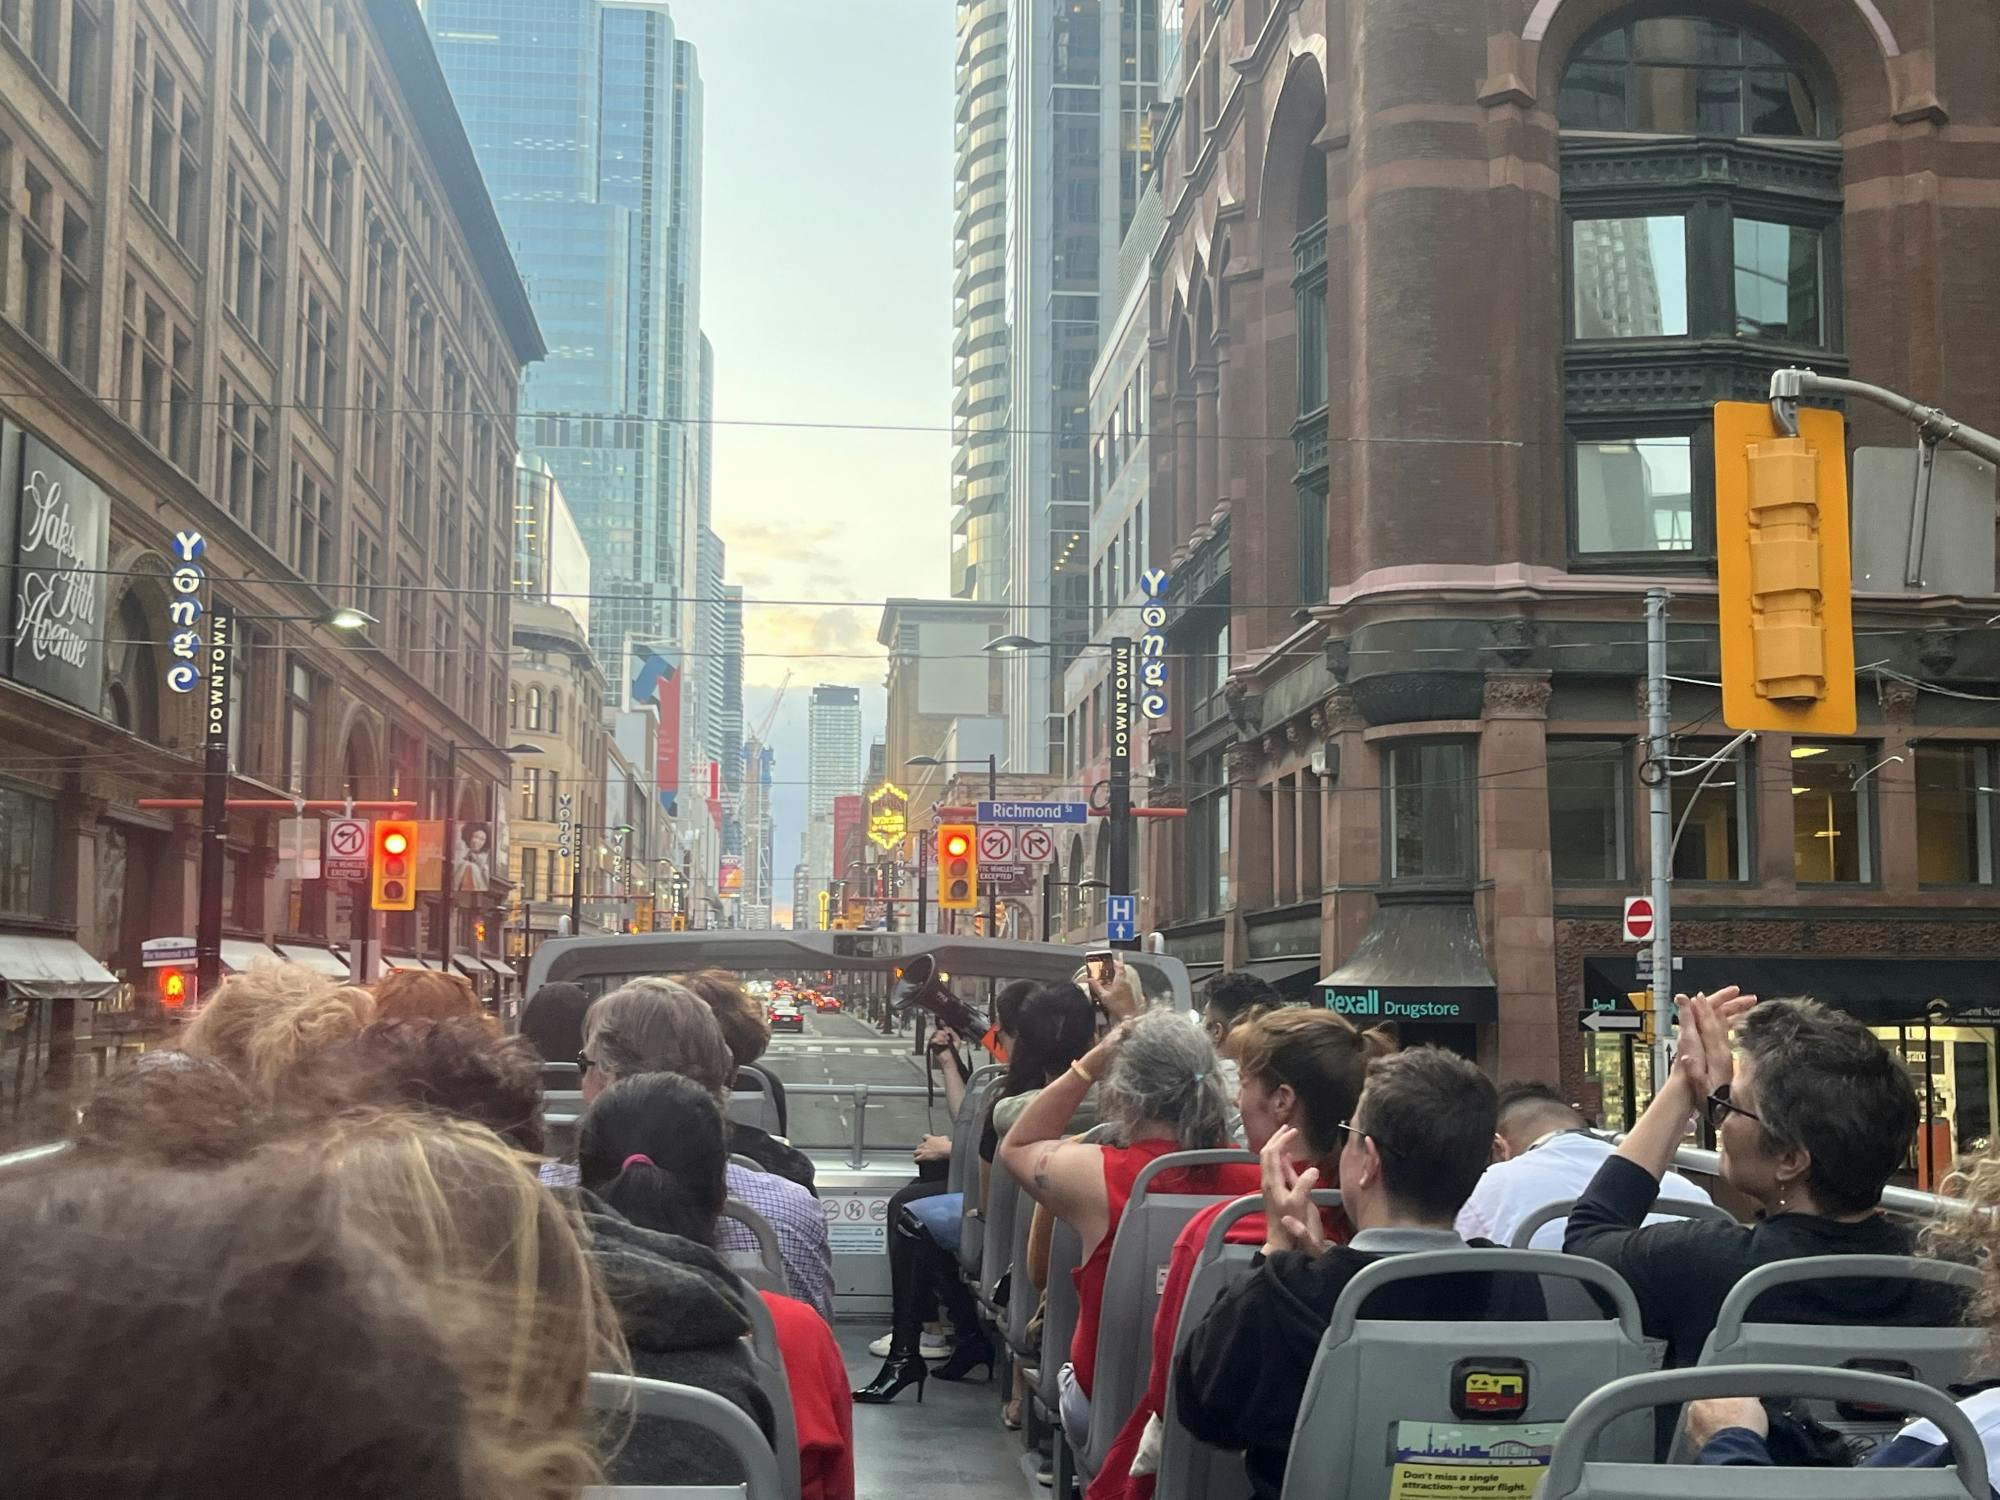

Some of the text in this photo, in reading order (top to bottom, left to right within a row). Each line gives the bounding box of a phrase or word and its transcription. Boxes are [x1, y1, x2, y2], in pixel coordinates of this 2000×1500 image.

[20, 470, 77, 558] Saks
[15, 572, 88, 668] Avenue
[49, 557, 94, 625] Fifth
[167, 531, 203, 692] Yonge
[210, 616, 227, 734] DOWNTOWN
[1142, 567, 1167, 718] Yonge
[1116, 648, 1128, 757] DOWNTOWN
[993, 804, 1062, 818] Richmond
[980, 872, 1012, 880] EXCEPTED
[1112, 899, 1130, 920] H
[1325, 989, 1378, 1014] Rexall
[1385, 1001, 1460, 1019] Drugstore
[1403, 1470, 1433, 1479] Don't
[1434, 1472, 1458, 1480] miss
[1469, 1473, 1499, 1484] single
[1472, 1484, 1496, 1493] your
[1498, 1482, 1527, 1493] flight.
